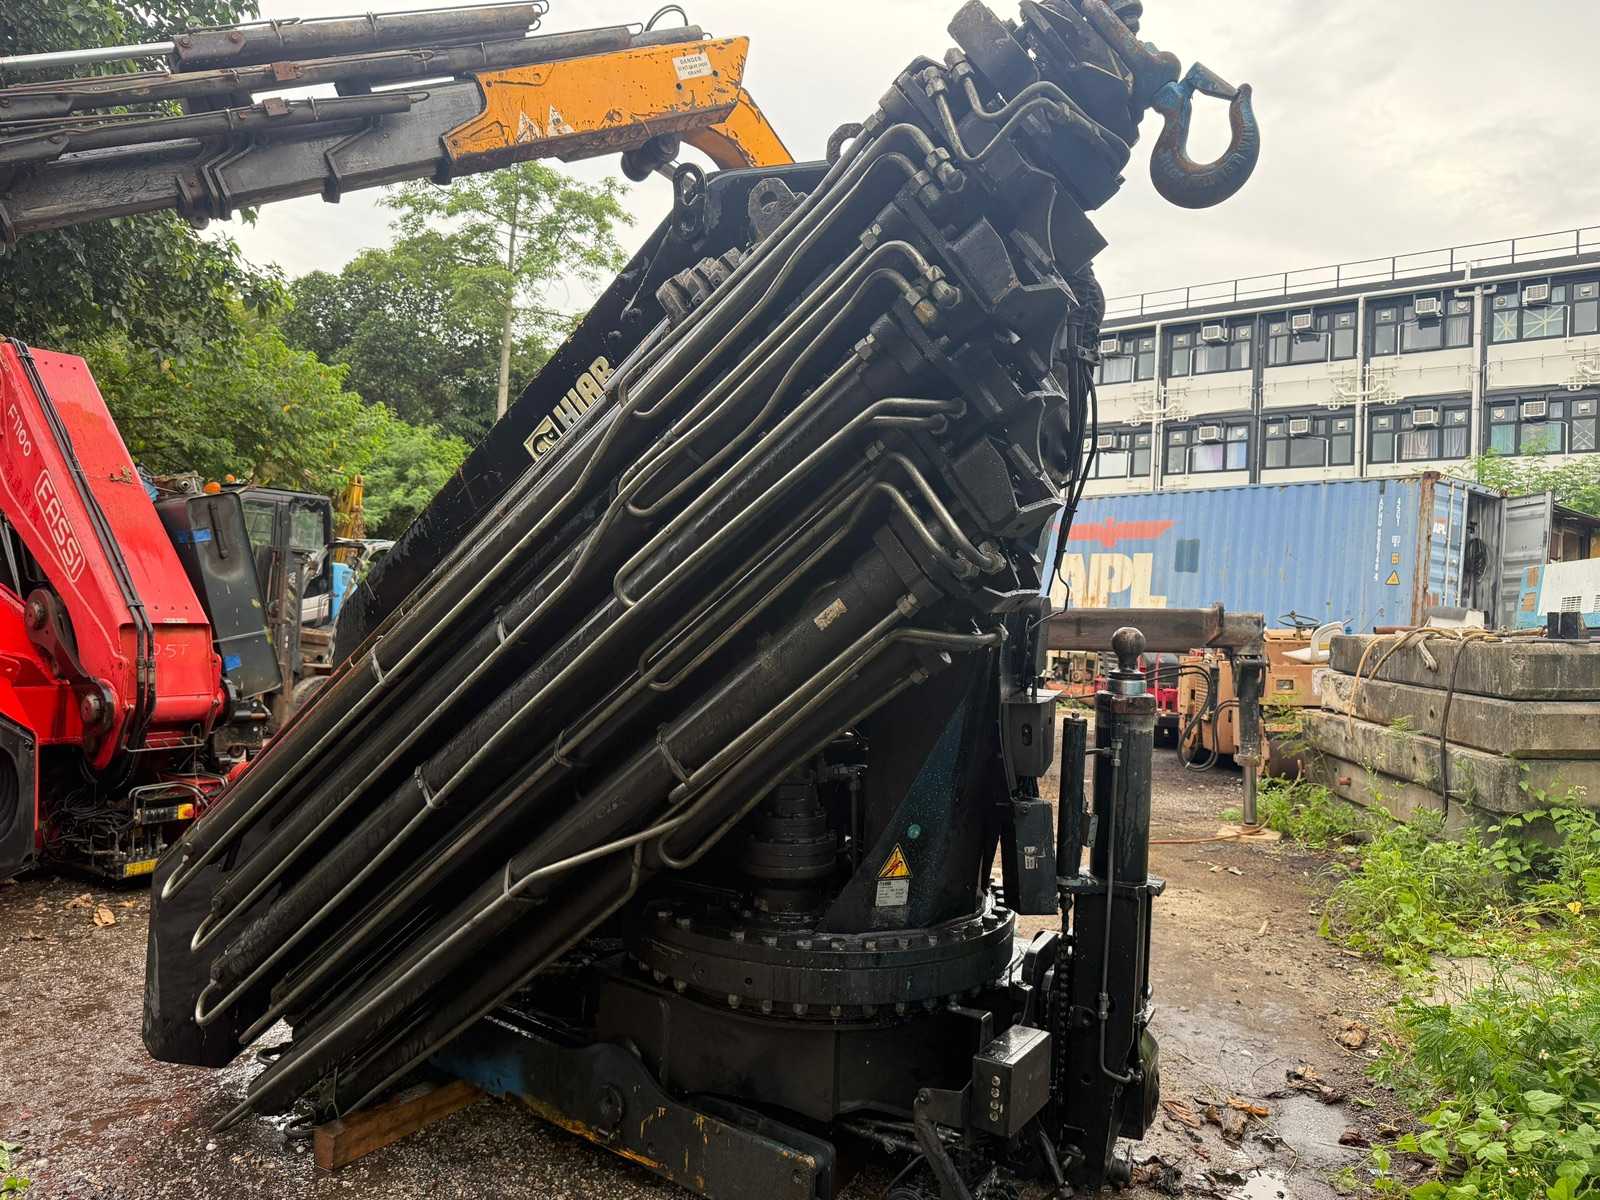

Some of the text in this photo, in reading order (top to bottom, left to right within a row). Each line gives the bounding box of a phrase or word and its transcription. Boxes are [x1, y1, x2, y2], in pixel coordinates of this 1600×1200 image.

[8, 404, 31, 457] F1100
[37, 482, 84, 575] FASSI
[1050, 553, 1168, 609] APL
